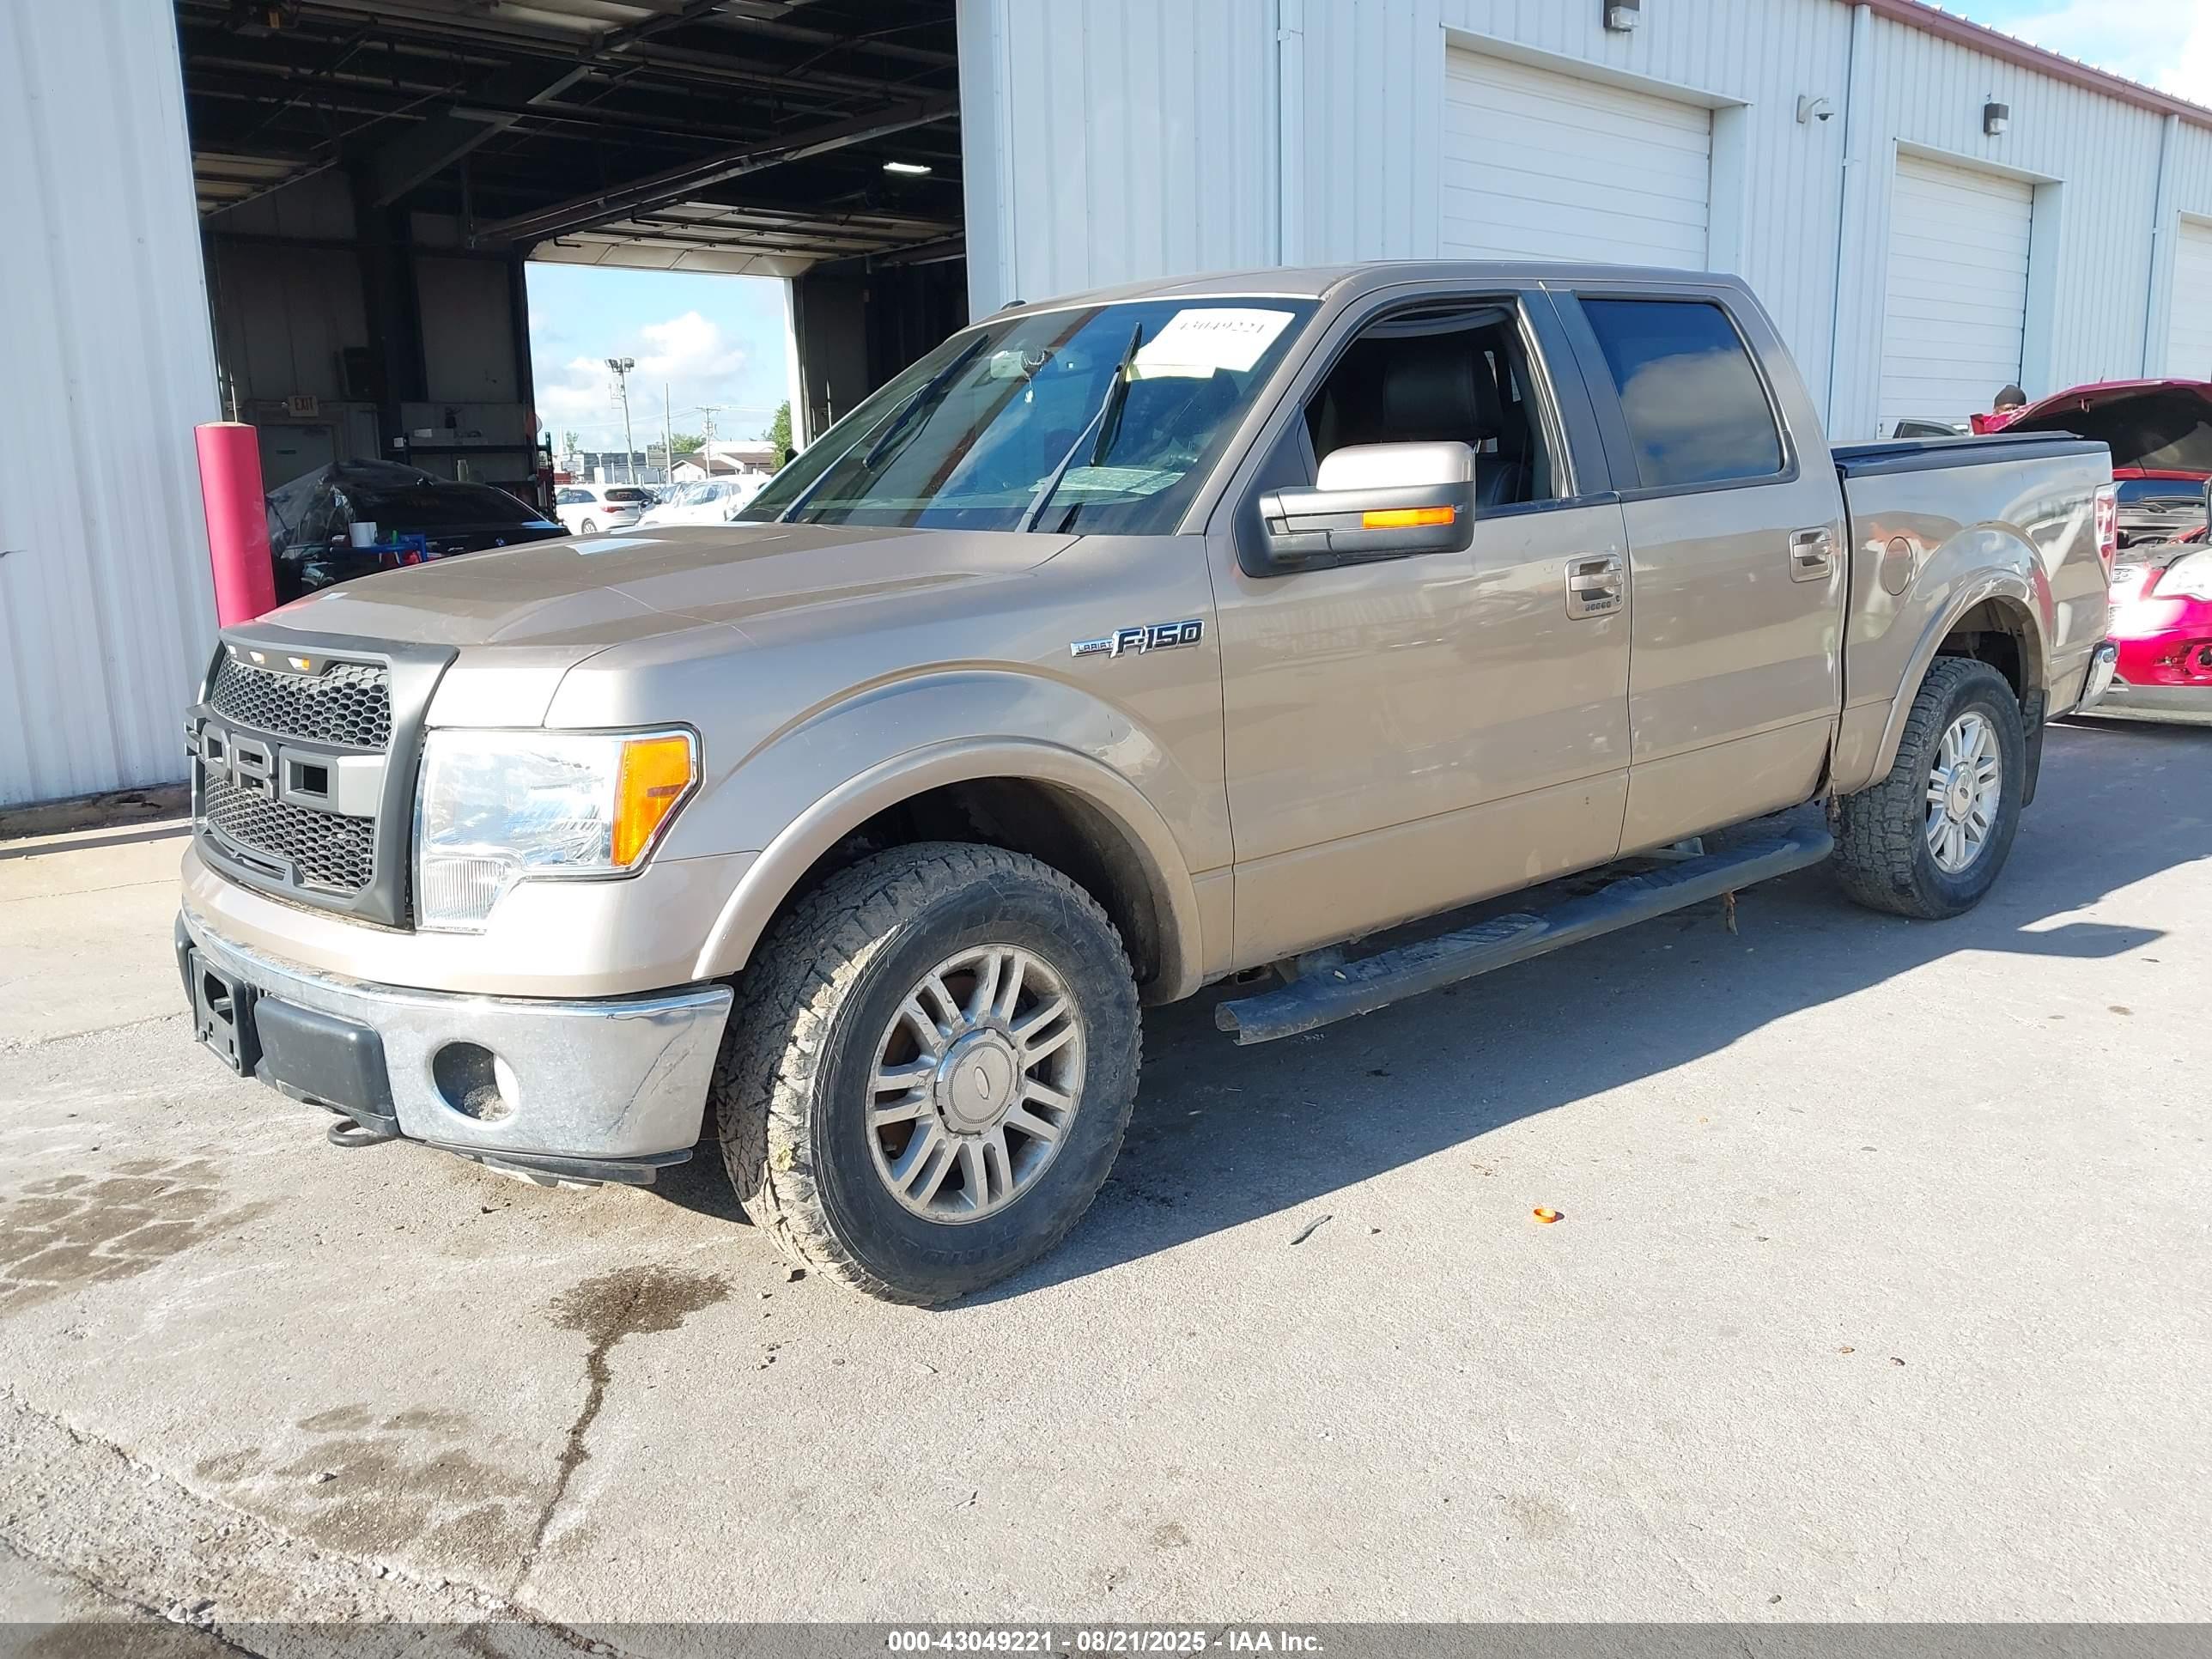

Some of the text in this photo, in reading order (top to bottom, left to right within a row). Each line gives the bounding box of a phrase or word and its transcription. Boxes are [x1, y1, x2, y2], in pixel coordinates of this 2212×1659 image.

[294, 397, 314, 411] EXIT
[1110, 618, 1205, 659] F-150
[183, 716, 338, 813] FORD
